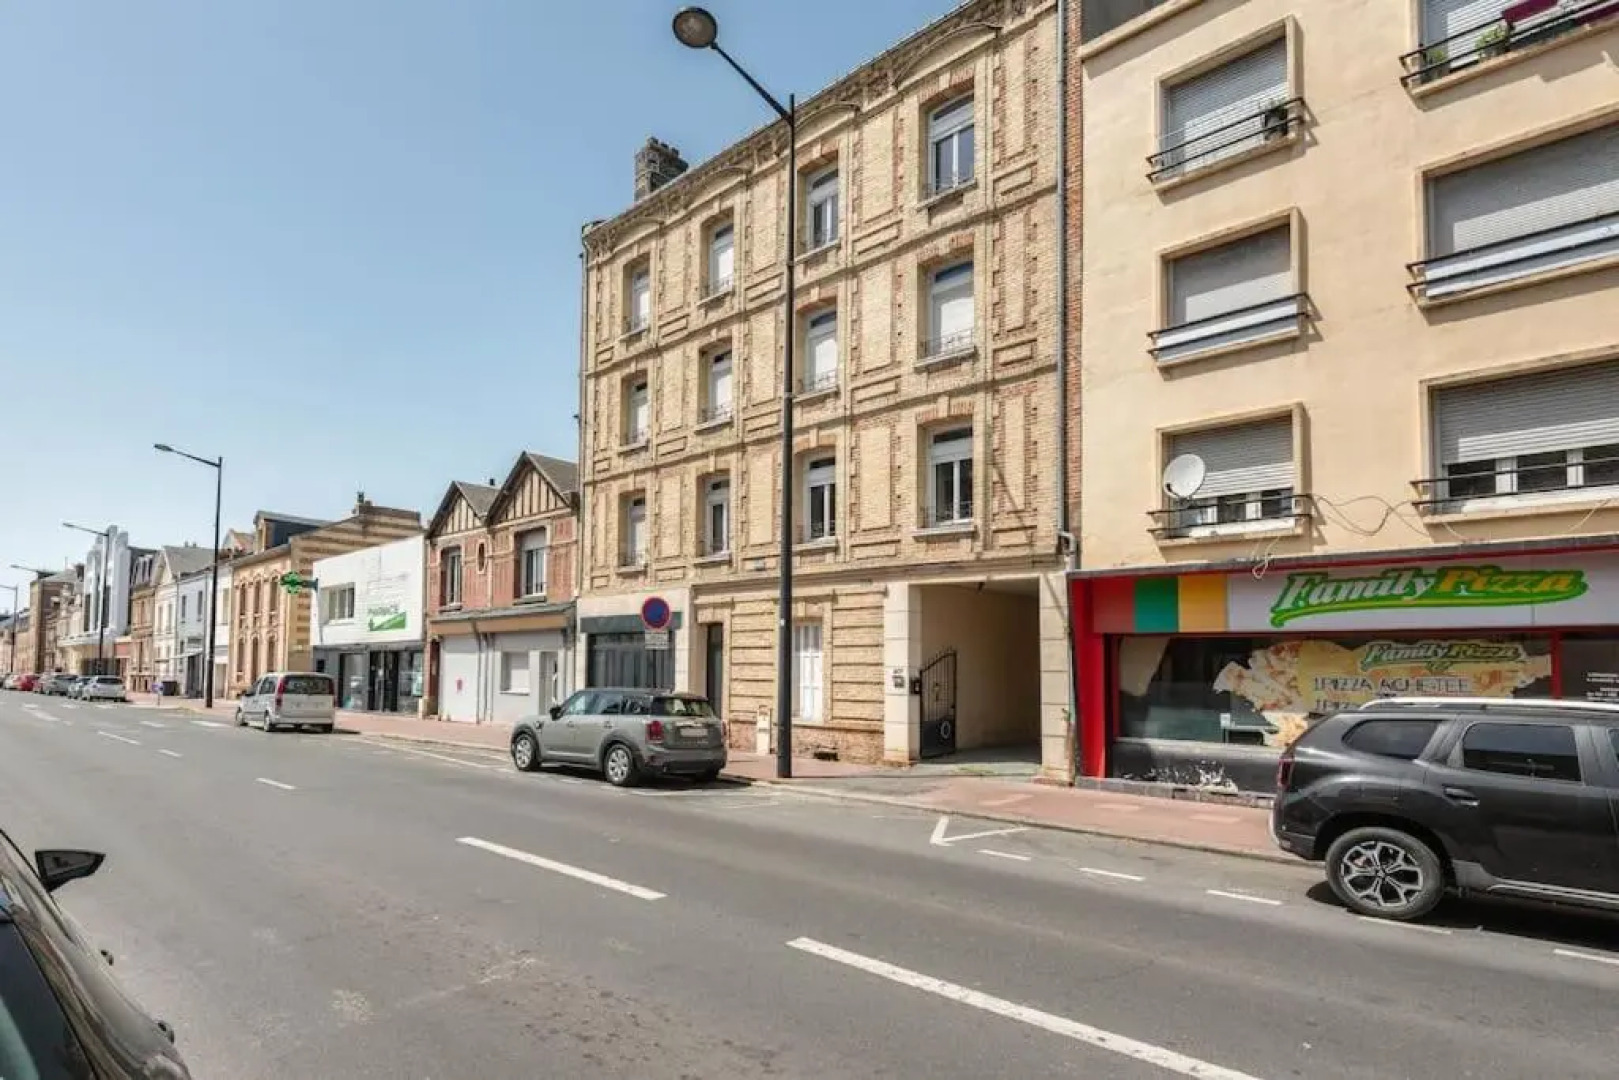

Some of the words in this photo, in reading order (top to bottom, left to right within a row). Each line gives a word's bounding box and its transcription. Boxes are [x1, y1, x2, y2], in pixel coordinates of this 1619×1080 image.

[1272, 569, 1437, 612] Family
[1437, 566, 1580, 594] Pizza
[1364, 643, 1450, 666] Family
